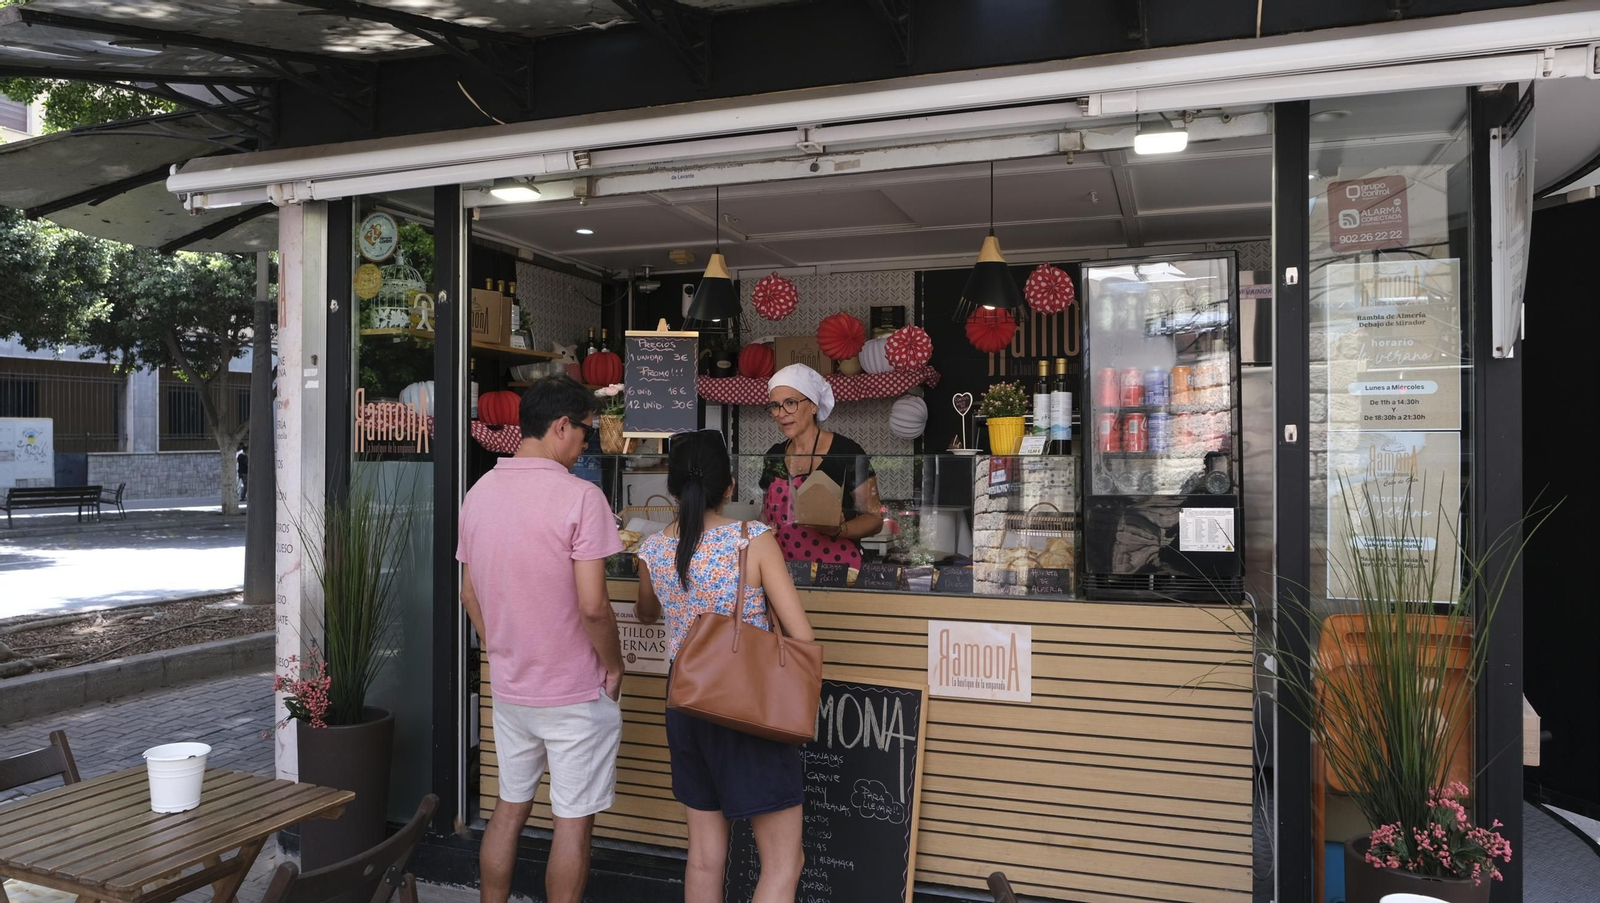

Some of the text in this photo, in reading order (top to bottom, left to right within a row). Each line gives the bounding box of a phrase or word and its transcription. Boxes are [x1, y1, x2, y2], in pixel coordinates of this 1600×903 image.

[1361, 182, 1386, 192] grupo
[1362, 187, 1390, 197] control
[1361, 206, 1402, 216] ALARMA
[1361, 214, 1402, 222] CONECTADA
[1340, 230, 1402, 244] 902 26 22 22
[1372, 338, 1414, 348] horario
[1376, 350, 1432, 364] verano
[628, 386, 634, 395] 6
[628, 400, 640, 409] 12
[672, 400, 694, 409] 30€
[958, 678, 974, 690] boutique
[975, 678, 980, 688] de
[981, 679, 984, 689] la
[986, 680, 1006, 691] empanada
[806, 771, 841, 783] CARNE
